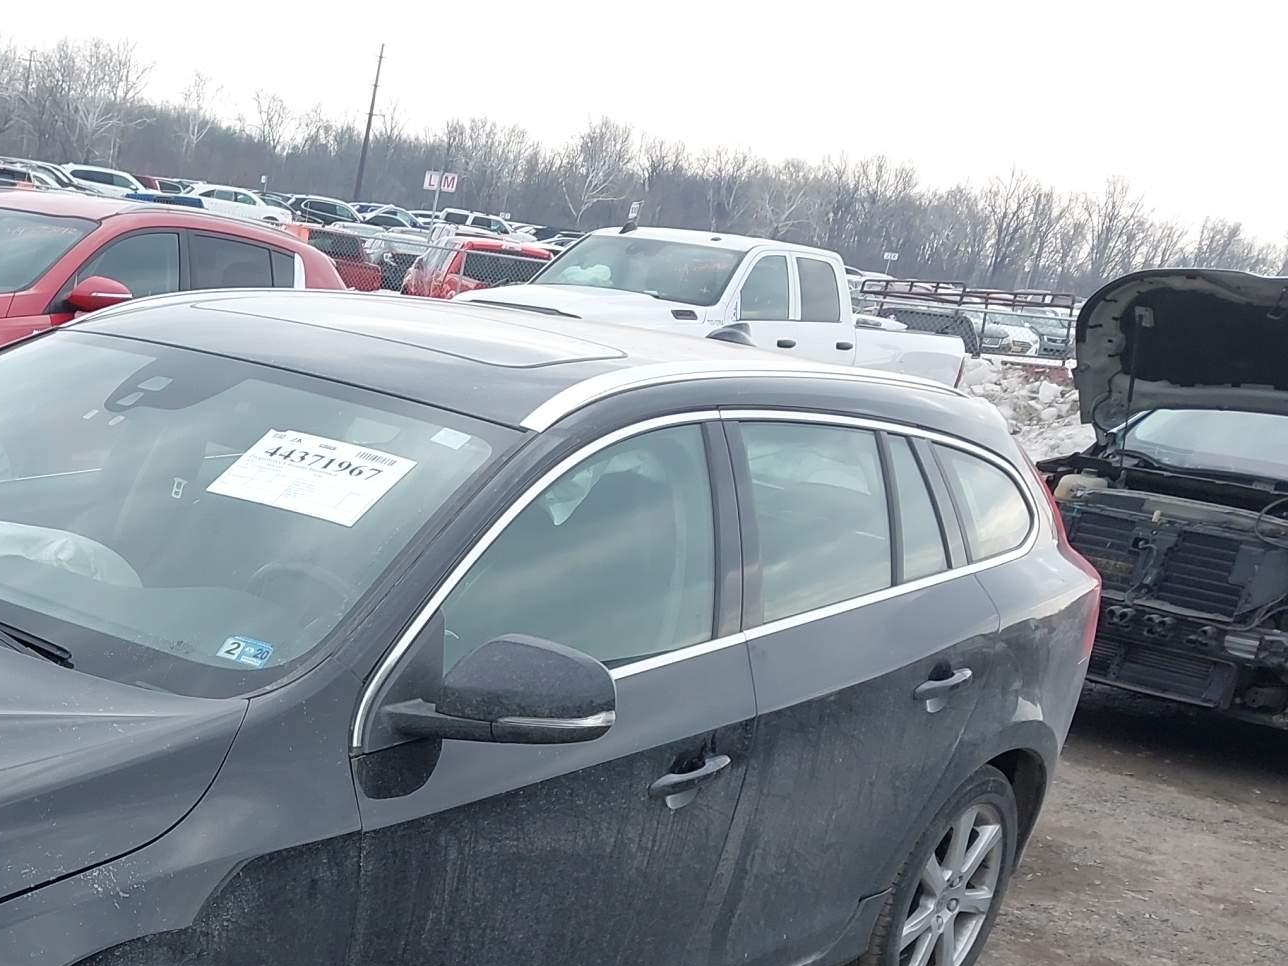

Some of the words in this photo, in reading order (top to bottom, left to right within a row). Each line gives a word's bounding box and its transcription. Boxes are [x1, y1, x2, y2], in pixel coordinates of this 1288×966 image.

[442, 175, 456, 189] M
[264, 446, 383, 480] 44371967
[224, 641, 241, 656] 2
